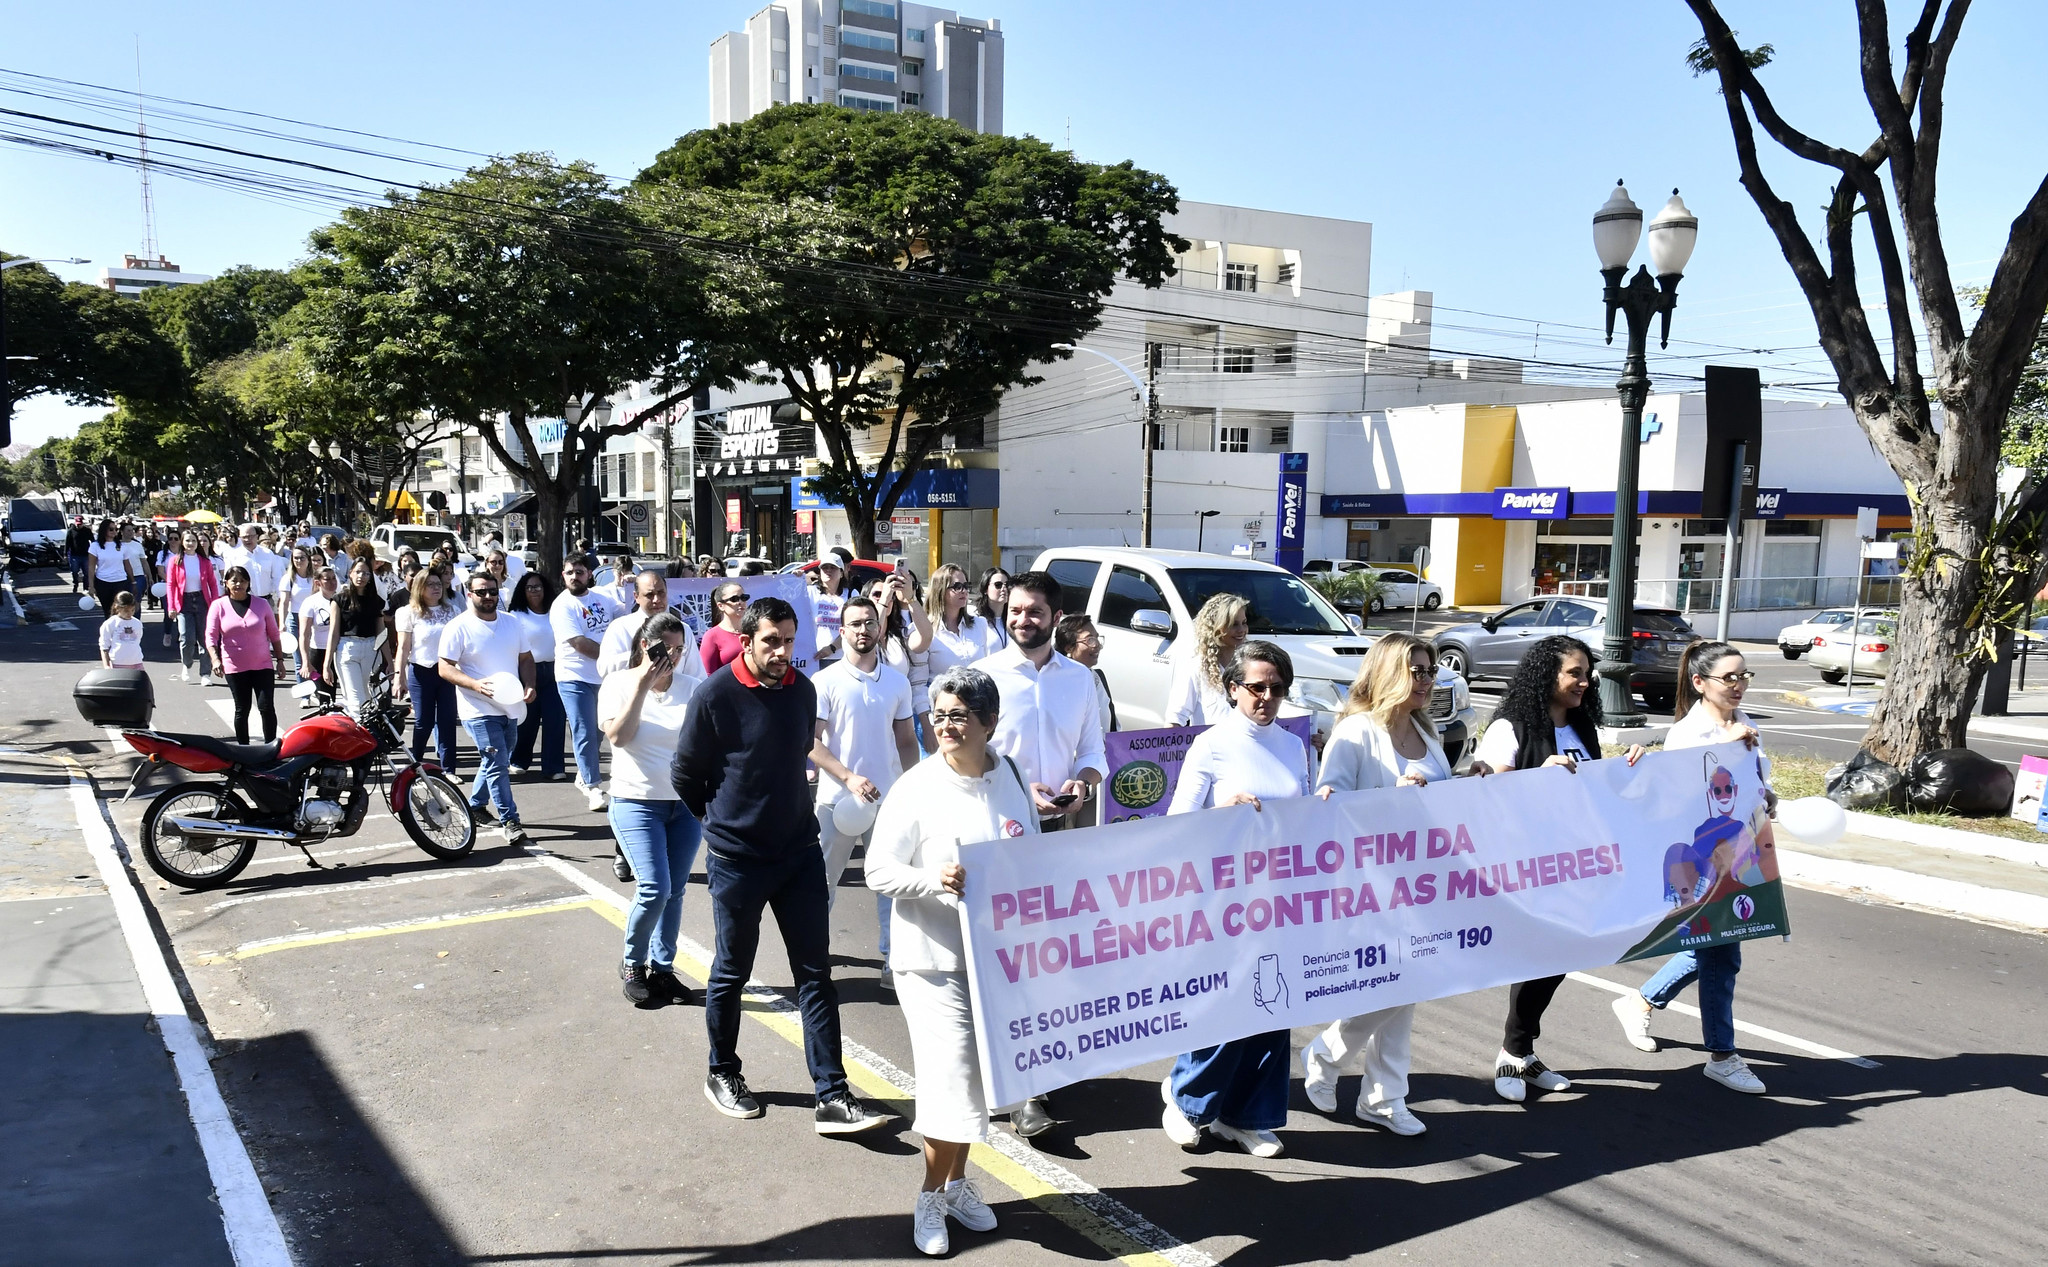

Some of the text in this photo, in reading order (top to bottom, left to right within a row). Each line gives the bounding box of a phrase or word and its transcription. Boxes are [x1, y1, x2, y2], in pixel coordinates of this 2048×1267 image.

[727, 405, 773, 434] VIRTUAL
[721, 430, 779, 459] ESPORTES
[927, 493, 956, 503] 056-5151
[1501, 492, 1559, 508] PanVel
[633, 508, 644, 516] 40
[1283, 482, 1297, 539] PanVel
[881, 523, 886, 531] E
[1129, 732, 1184, 751] ASSOCIAÇÃO
[992, 824, 1476, 931] PELA VIDA E PELO FIM DA
[995, 843, 1624, 983] VIOLÊNCIA CONTRA AS MULHERES!
[1410, 925, 1493, 949] Denúncia 190
[1680, 932, 1712, 946] PARANÁ
[1720, 923, 1776, 938] MULHER SEGURA
[1303, 943, 1387, 969] Denúncia 181
[1411, 945, 1439, 959] crime:
[1303, 964, 1350, 979] anônima:
[1305, 972, 1400, 1001] policiacivil.pr.gov.br
[1009, 971, 1228, 1040] SE SOUBER DE ALGUM
[1014, 1011, 1188, 1072] CASO, DENUNCIE.
